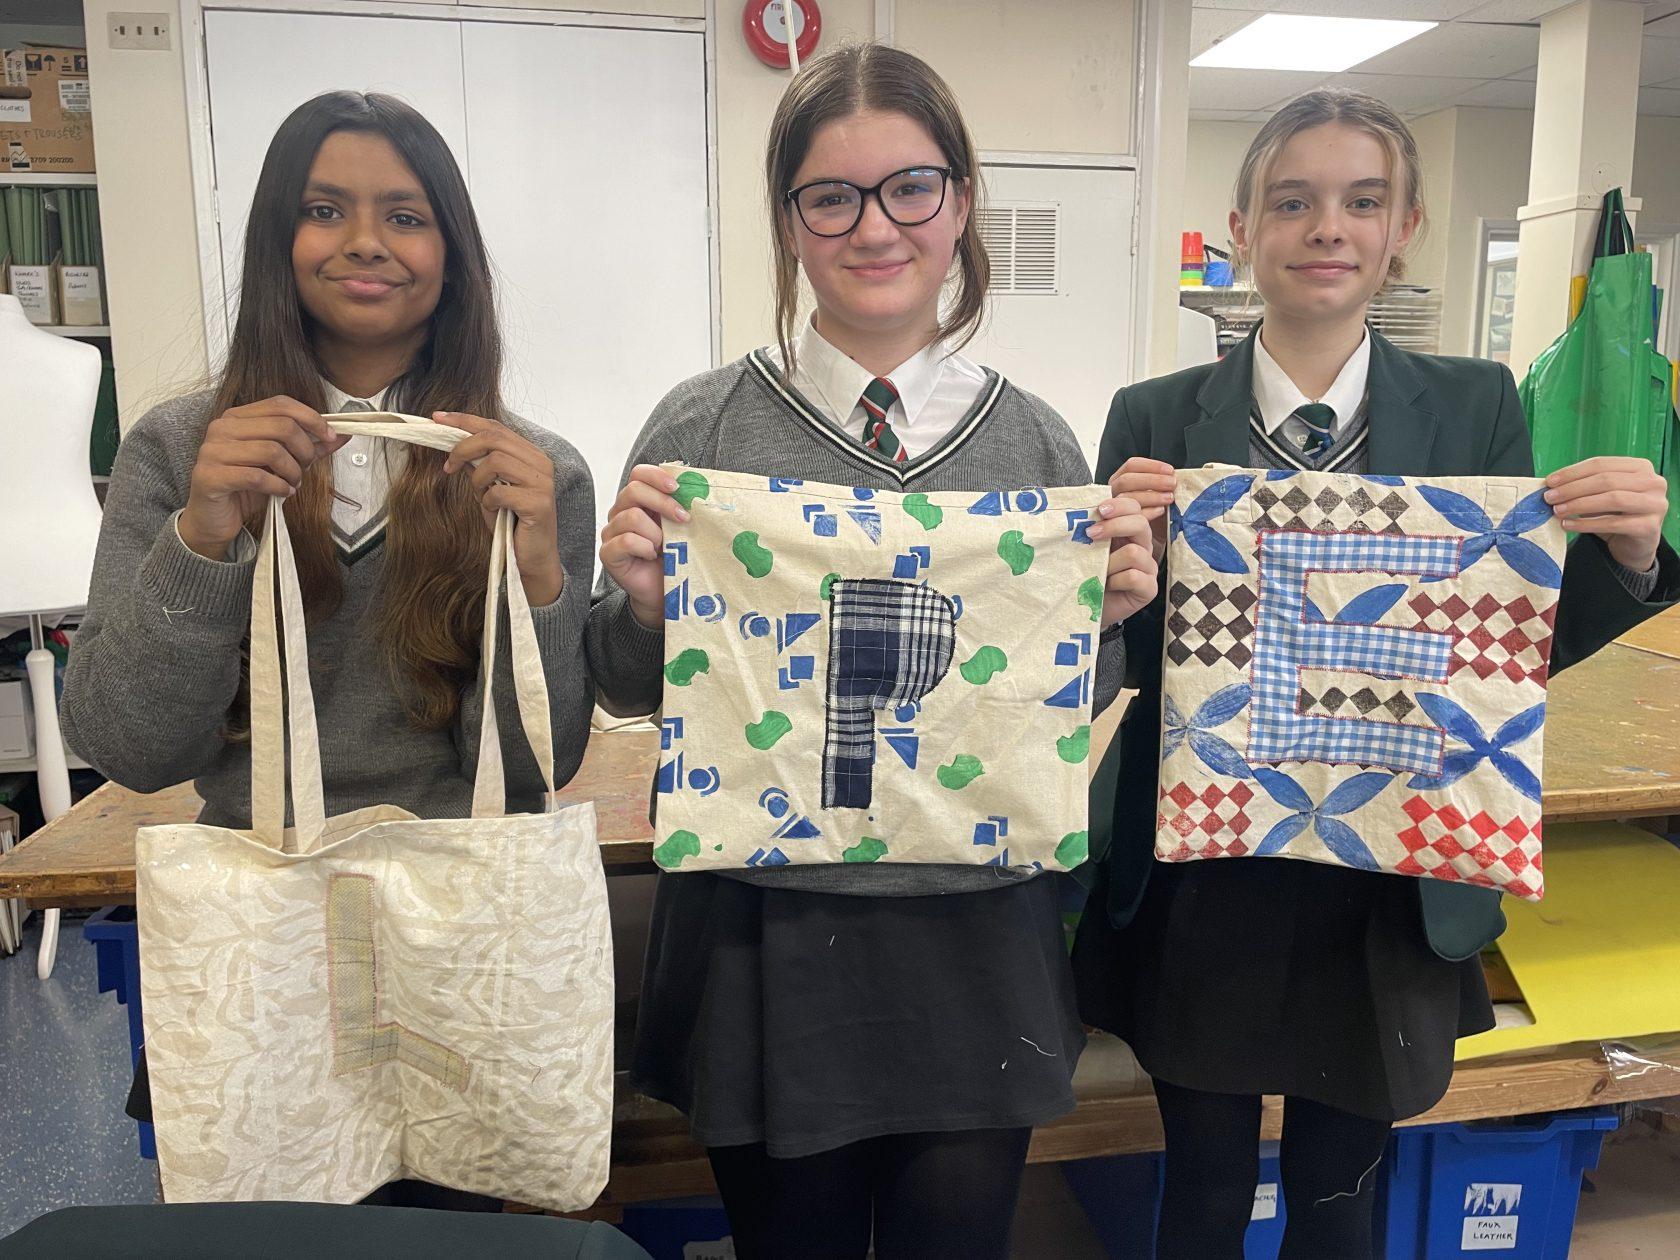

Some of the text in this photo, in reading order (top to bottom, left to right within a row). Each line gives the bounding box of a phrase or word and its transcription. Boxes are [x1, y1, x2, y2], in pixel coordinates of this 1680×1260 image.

[821, 578, 956, 809] P
[1247, 529, 1464, 777] E
[324, 872, 471, 1093] L
[1477, 1221, 1501, 1229] FAUX
